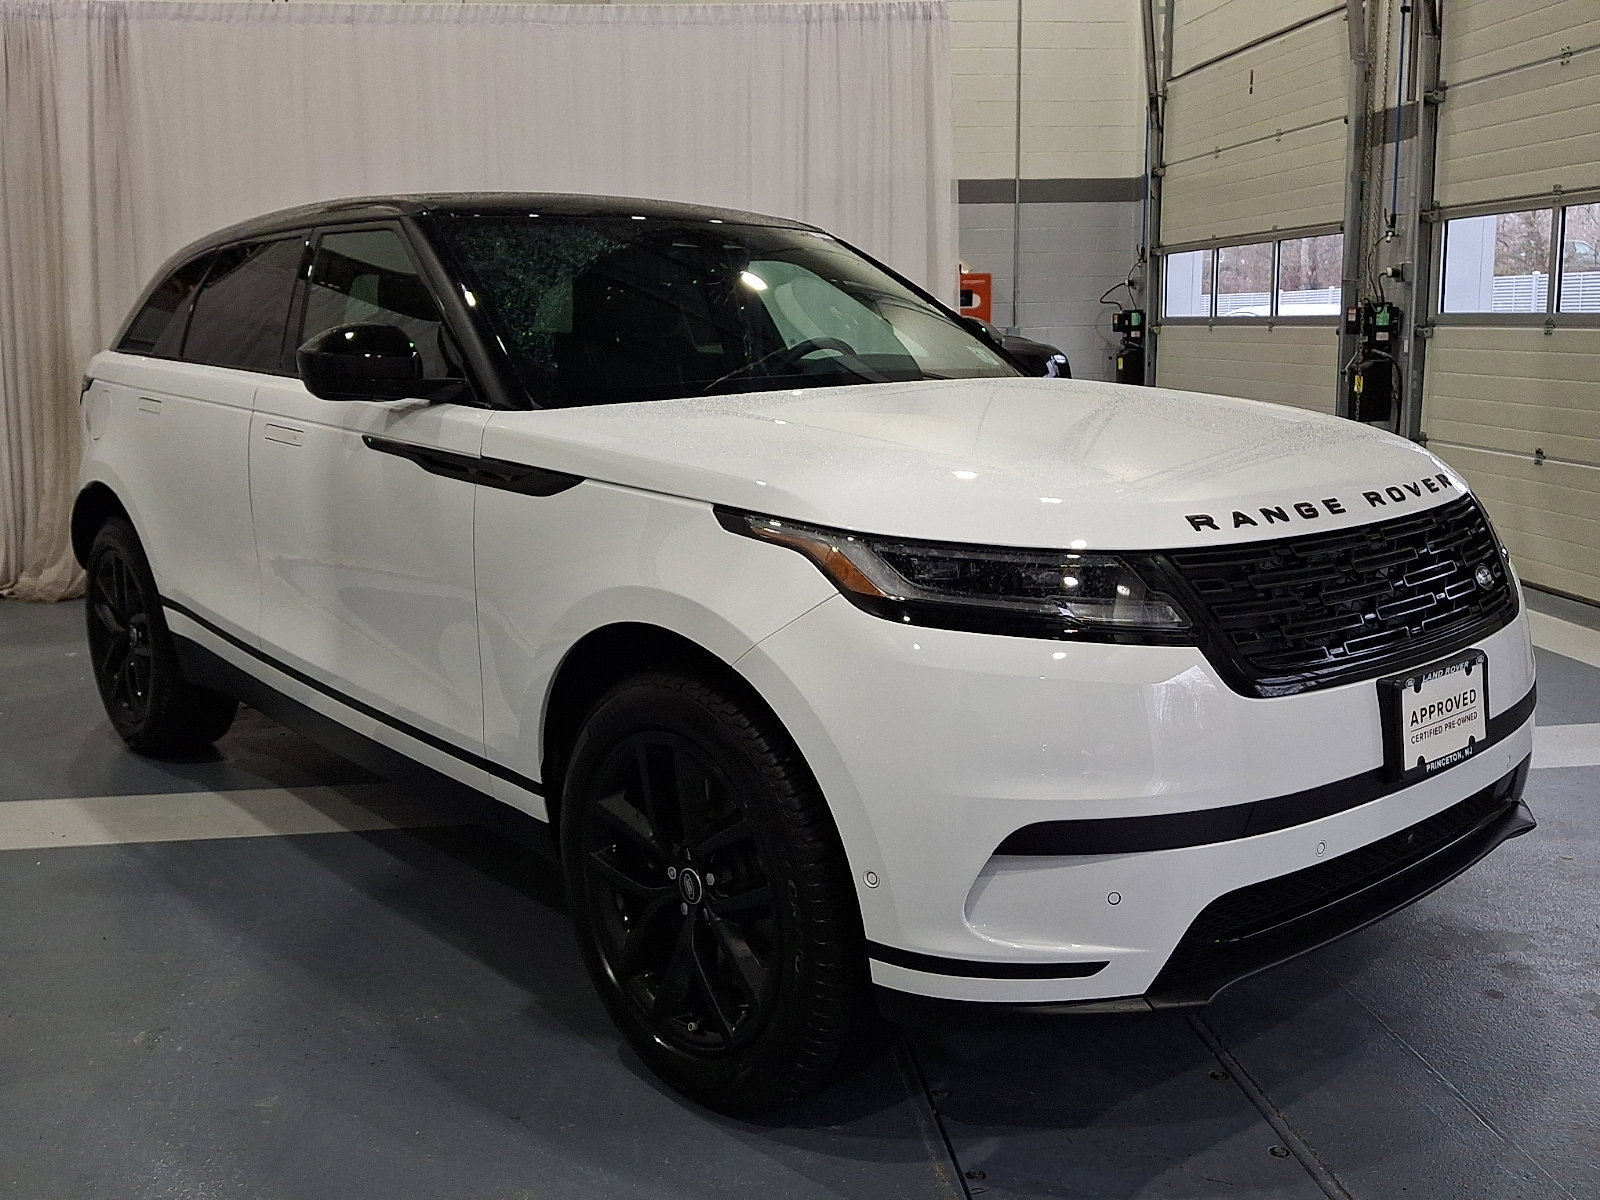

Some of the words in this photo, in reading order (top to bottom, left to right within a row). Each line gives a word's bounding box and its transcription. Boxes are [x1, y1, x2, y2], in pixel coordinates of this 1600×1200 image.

[1185, 497, 1347, 532] RANGE
[1362, 473, 1453, 508] ROVER
[1422, 669, 1444, 682] LAND
[1445, 661, 1469, 674] ROVER
[1410, 689, 1477, 727] APPROVED
[1410, 725, 1443, 745] CERTIFIED
[1444, 711, 1478, 732] PRE-OWNED
[1426, 750, 1465, 772] PRINCETON,
[1464, 746, 1473, 757] NJ
